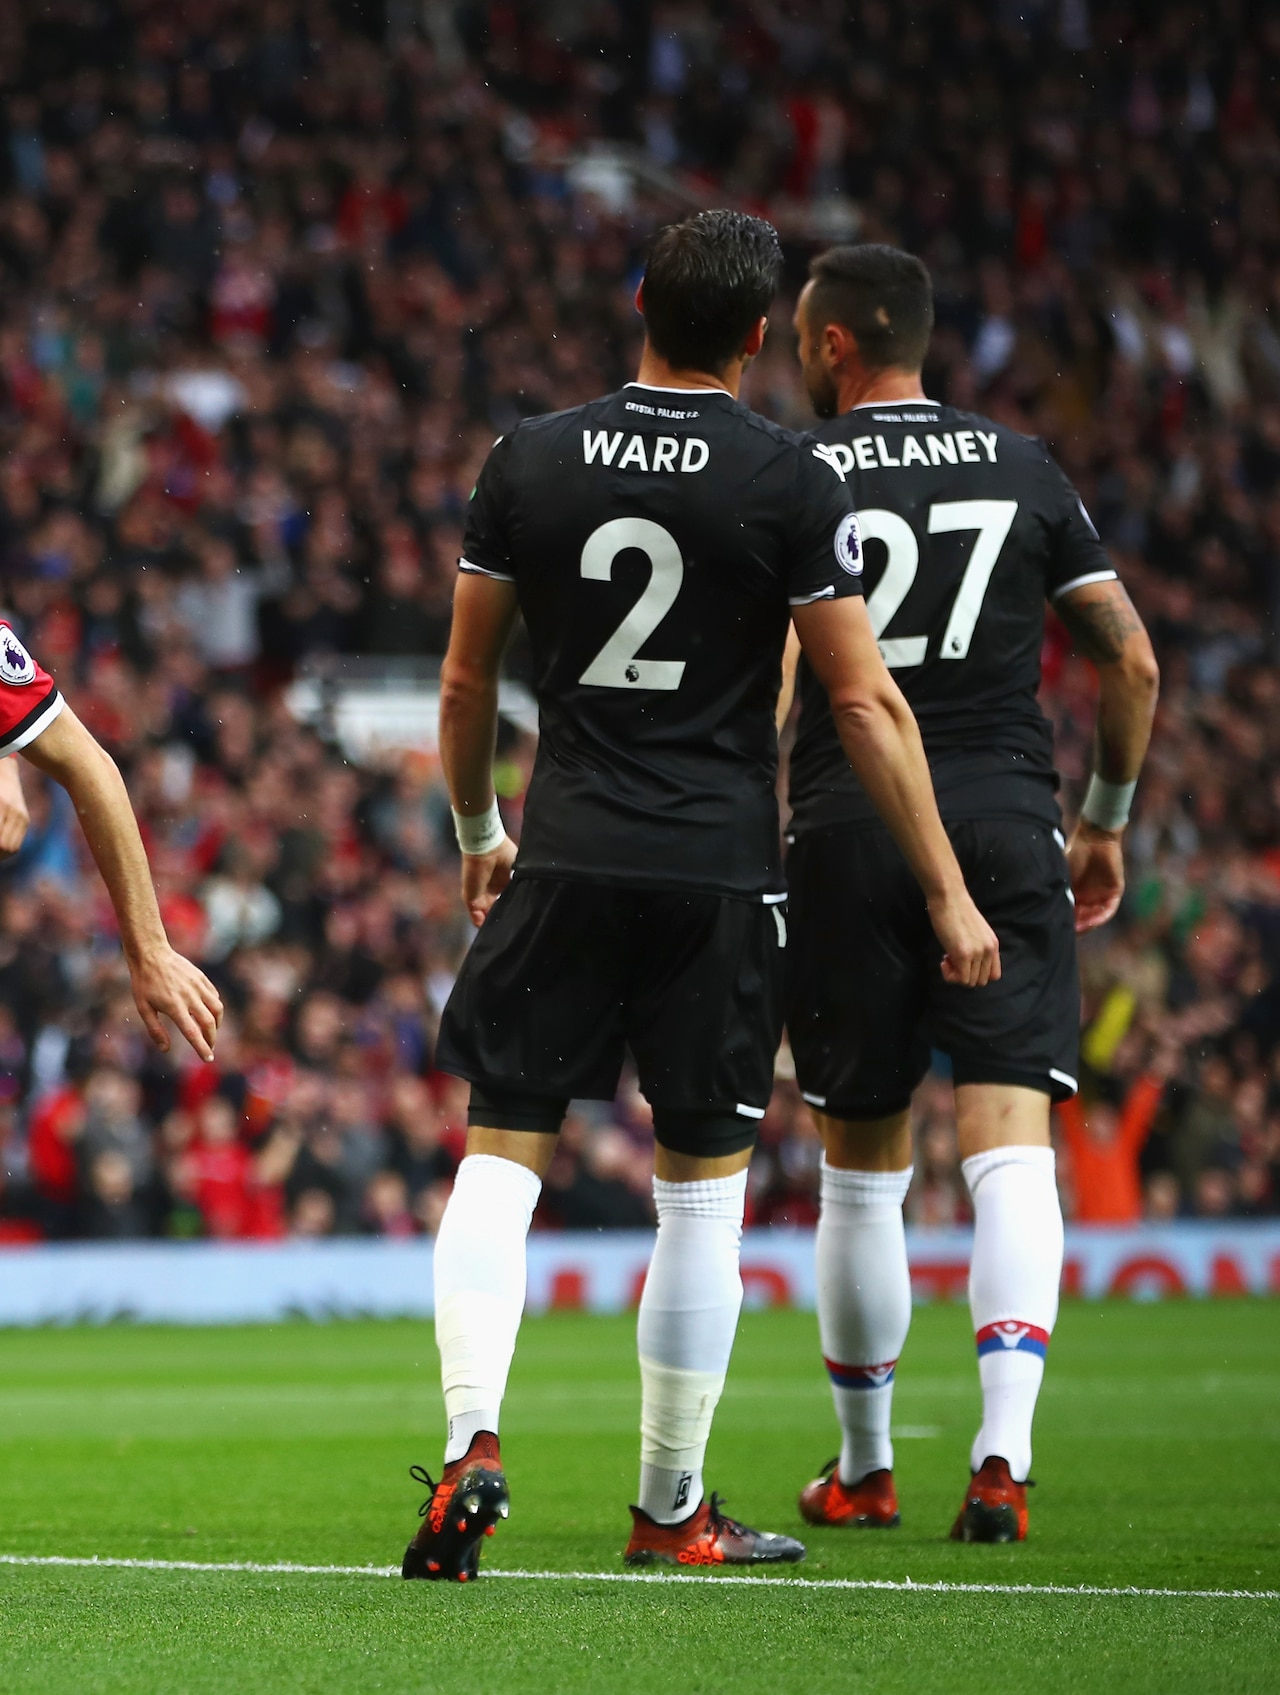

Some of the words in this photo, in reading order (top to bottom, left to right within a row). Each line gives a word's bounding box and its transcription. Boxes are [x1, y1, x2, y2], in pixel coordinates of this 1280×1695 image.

[625, 401, 656, 416] CRYSTAL
[657, 407, 686, 420] PALACE
[583, 429, 710, 473] WARD
[828, 430, 998, 474] DELANEY
[578, 517, 686, 690] 2
[853, 499, 1019, 669] 27
